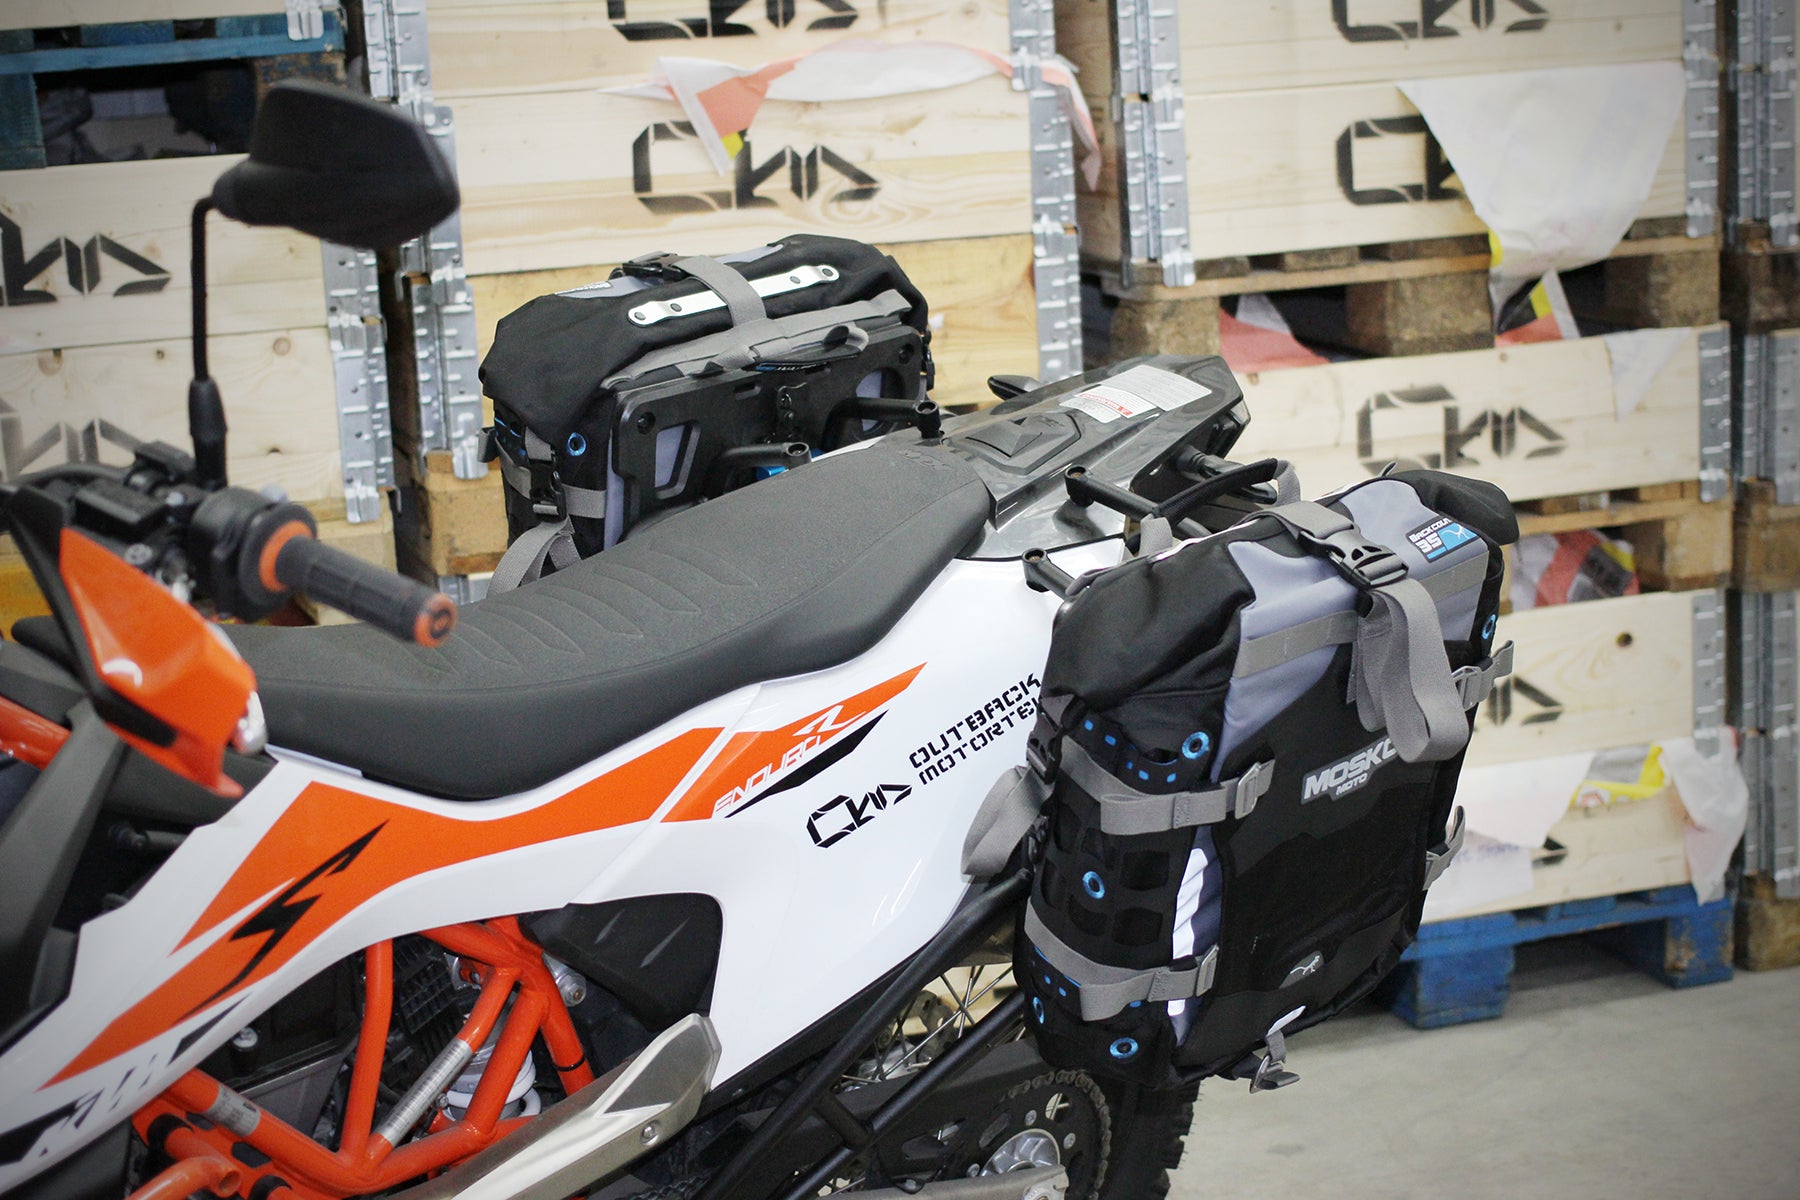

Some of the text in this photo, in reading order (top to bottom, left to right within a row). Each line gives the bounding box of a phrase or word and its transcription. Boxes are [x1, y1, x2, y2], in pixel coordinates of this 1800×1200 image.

[1415, 531, 1443, 554] 35
[908, 672, 1042, 769] OUTBACK
[713, 735, 822, 815] ENDURO
[1335, 772, 1368, 796] MOTO
